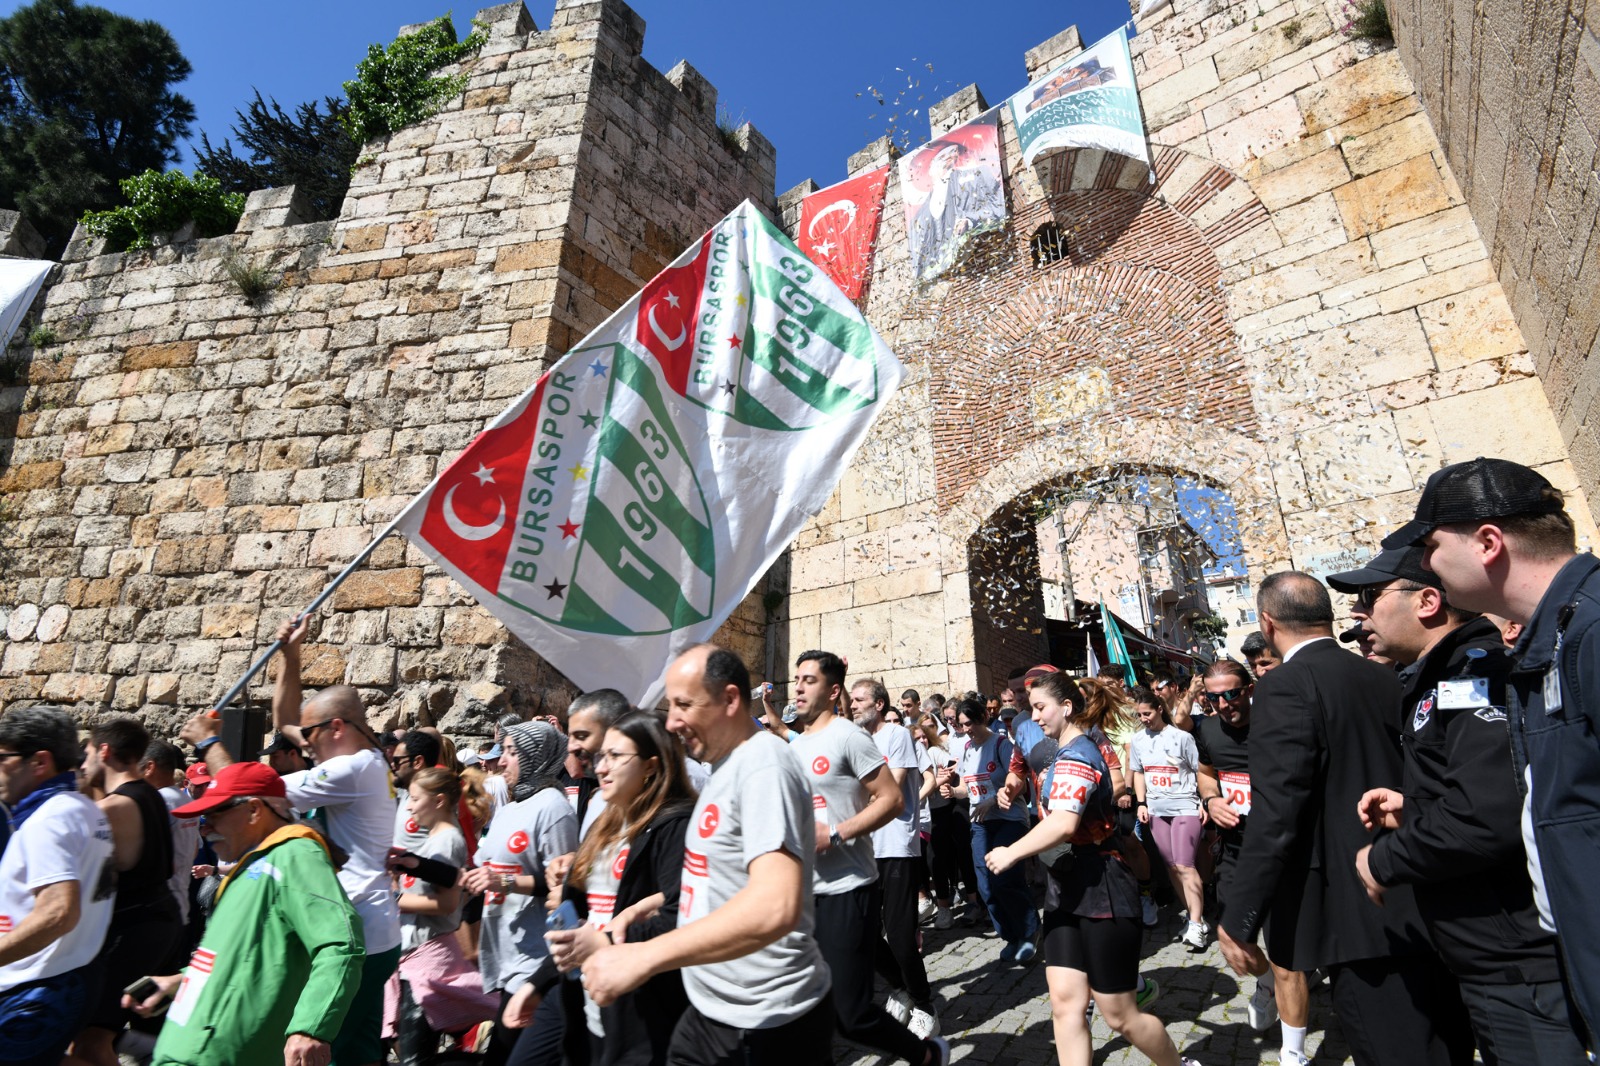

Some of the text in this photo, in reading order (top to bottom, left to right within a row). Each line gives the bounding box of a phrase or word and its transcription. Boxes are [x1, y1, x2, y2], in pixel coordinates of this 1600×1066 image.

[1023, 97, 1071, 127] OSMAN
[693, 232, 732, 385] BURSASPOR
[776, 256, 814, 384] 1963
[509, 371, 577, 583] BURSASPOR
[618, 418, 669, 581] 1963
[1049, 781, 1087, 806] 224
[1151, 775, 1172, 788] 581
